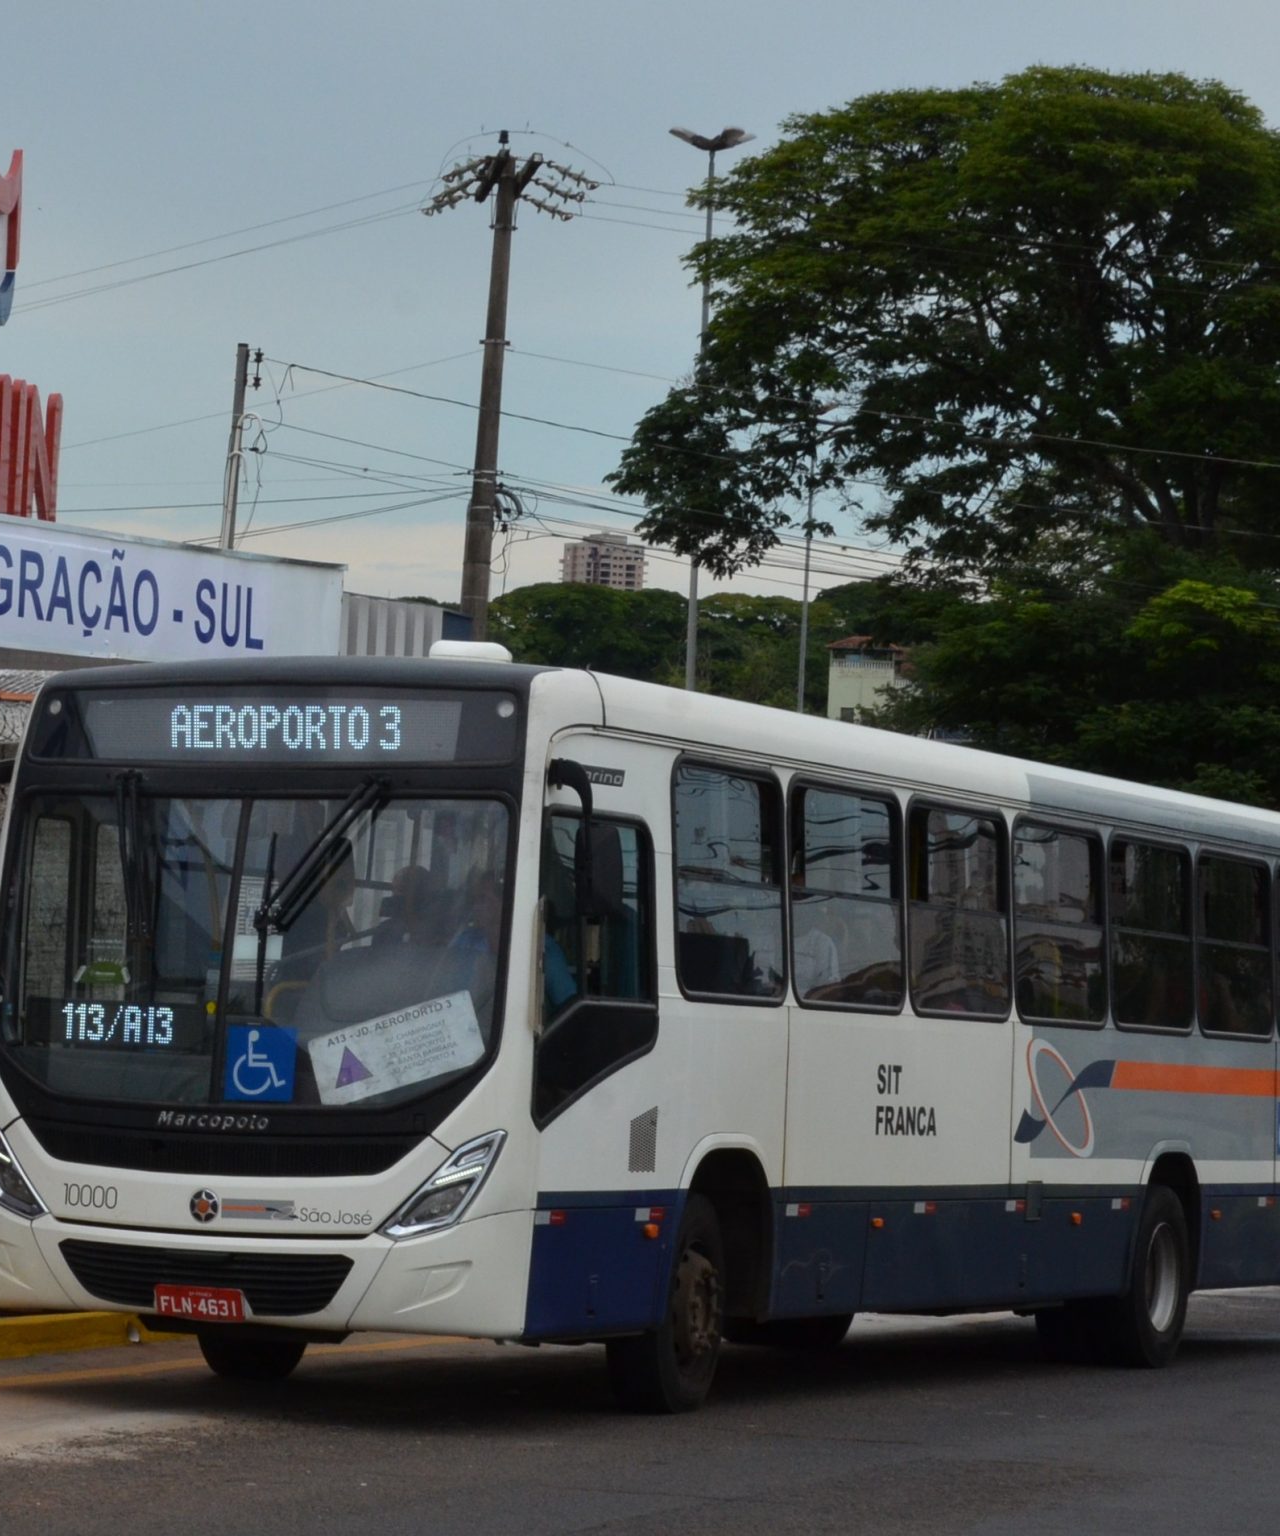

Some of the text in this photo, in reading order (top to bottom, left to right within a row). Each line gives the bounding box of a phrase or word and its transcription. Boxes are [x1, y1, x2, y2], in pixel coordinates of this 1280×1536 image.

[173, 609, 184, 623] -
[194, 578, 264, 651] SUL
[171, 705, 401, 750] AEROPORTO 3
[62, 1002, 174, 1044] 113/A13
[327, 1035, 347, 1047] A13
[374, 1003, 443, 1031] AEROPORTO
[445, 999, 452, 1008] 3
[877, 1064, 902, 1094] SIT
[875, 1106, 936, 1136] FRANCA
[64, 1183, 118, 1209] 10000
[300, 1207, 372, 1225] São José
